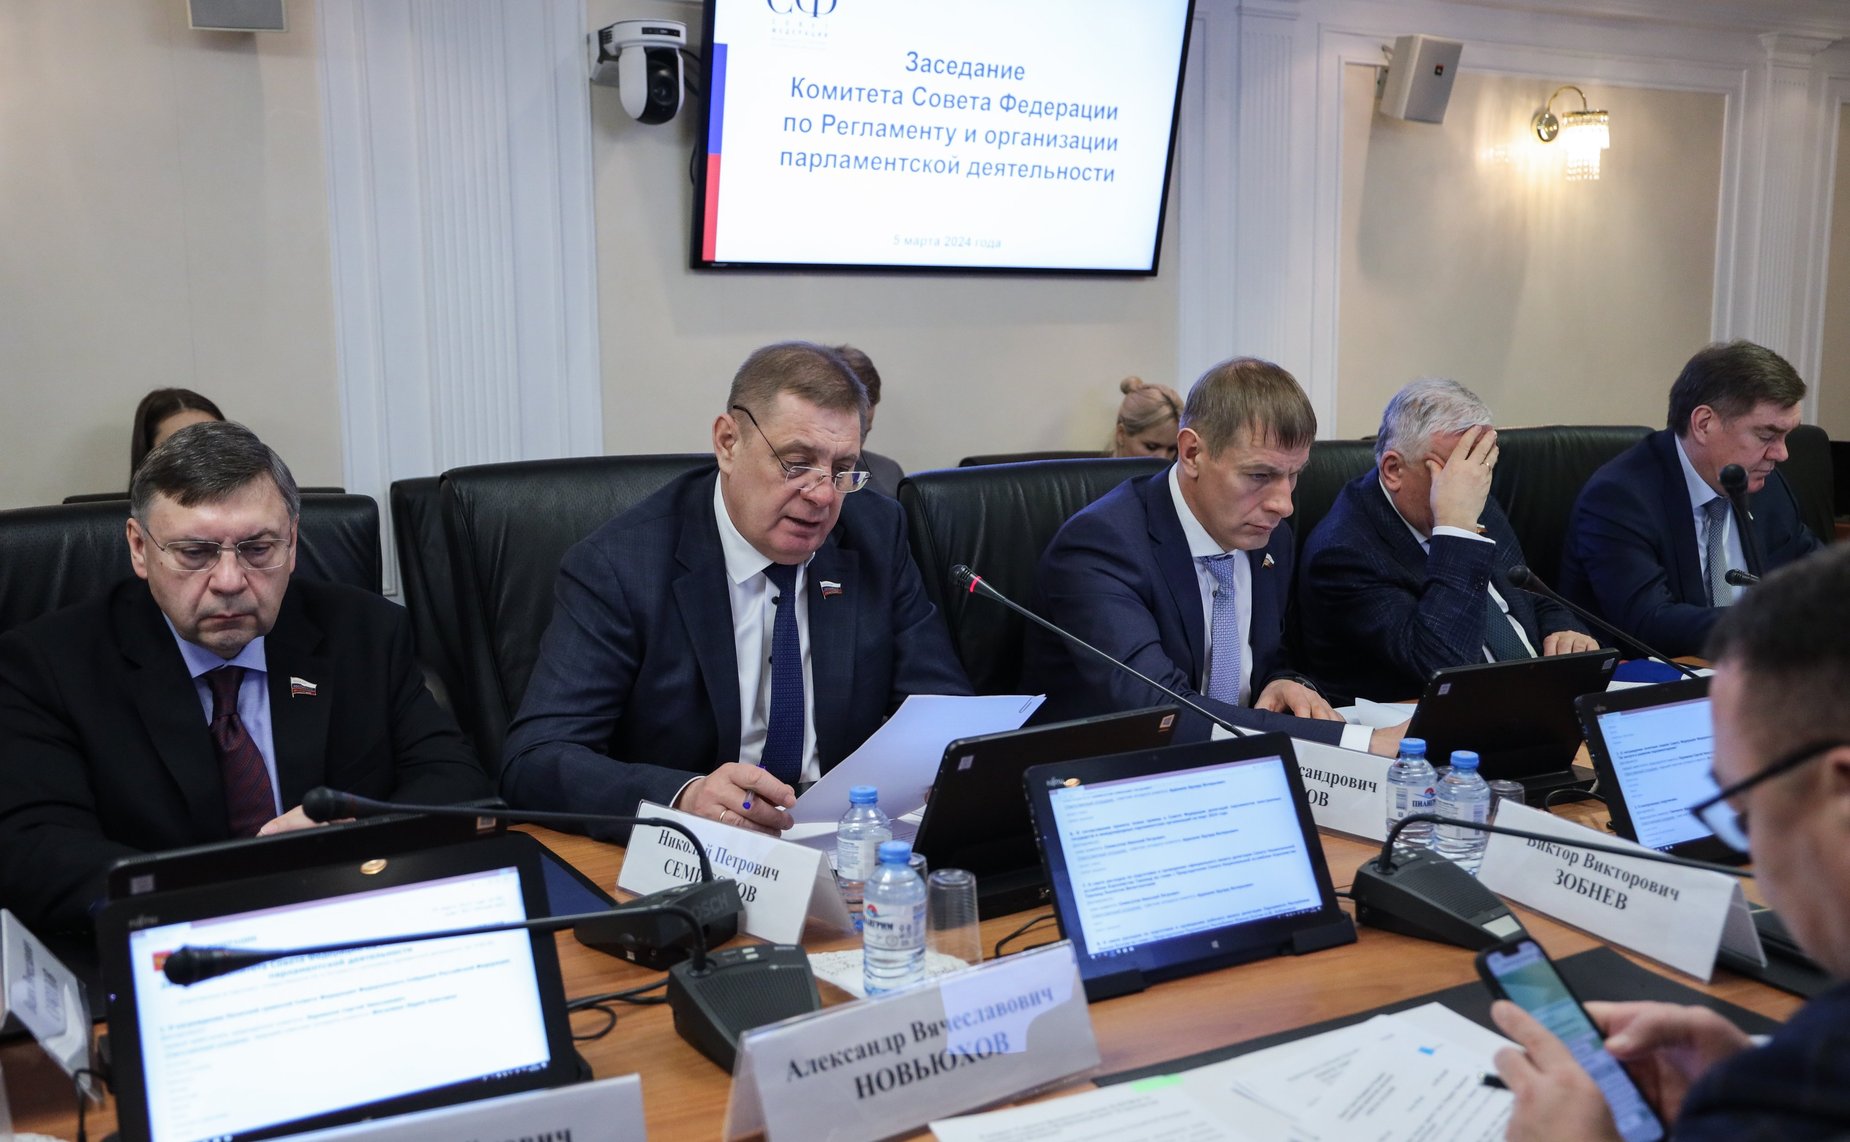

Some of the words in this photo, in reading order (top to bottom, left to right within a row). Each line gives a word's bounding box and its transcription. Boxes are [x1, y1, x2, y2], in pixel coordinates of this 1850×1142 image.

[905, 51, 1025, 81] Заседание
[790, 77, 904, 105] Комитета
[912, 86, 991, 111] Совета
[999, 93, 1119, 122] Федерации
[784, 116, 812, 133] по
[821, 114, 957, 146] Регламенту
[964, 129, 977, 143] и
[984, 128, 1119, 153] организации
[780, 150, 960, 176] парламентской
[967, 159, 1115, 183] деятельности
[904, 236, 940, 248] марта
[944, 235, 972, 247] 2024
[975, 238, 1002, 249] года
[1299, 766, 1378, 793] сандрович
[1306, 788, 1329, 807] ОВ
[658, 829, 713, 860] Никой
[714, 846, 780, 881] Петрович
[1553, 868, 1628, 911] ЗОБНЕВ
[1583, 853, 1682, 902] Викторович
[786, 1034, 907, 1083] Александр
[910, 987, 1054, 1044] Вячеславович
[854, 1032, 1011, 1100] НОВЬЮХОВ
